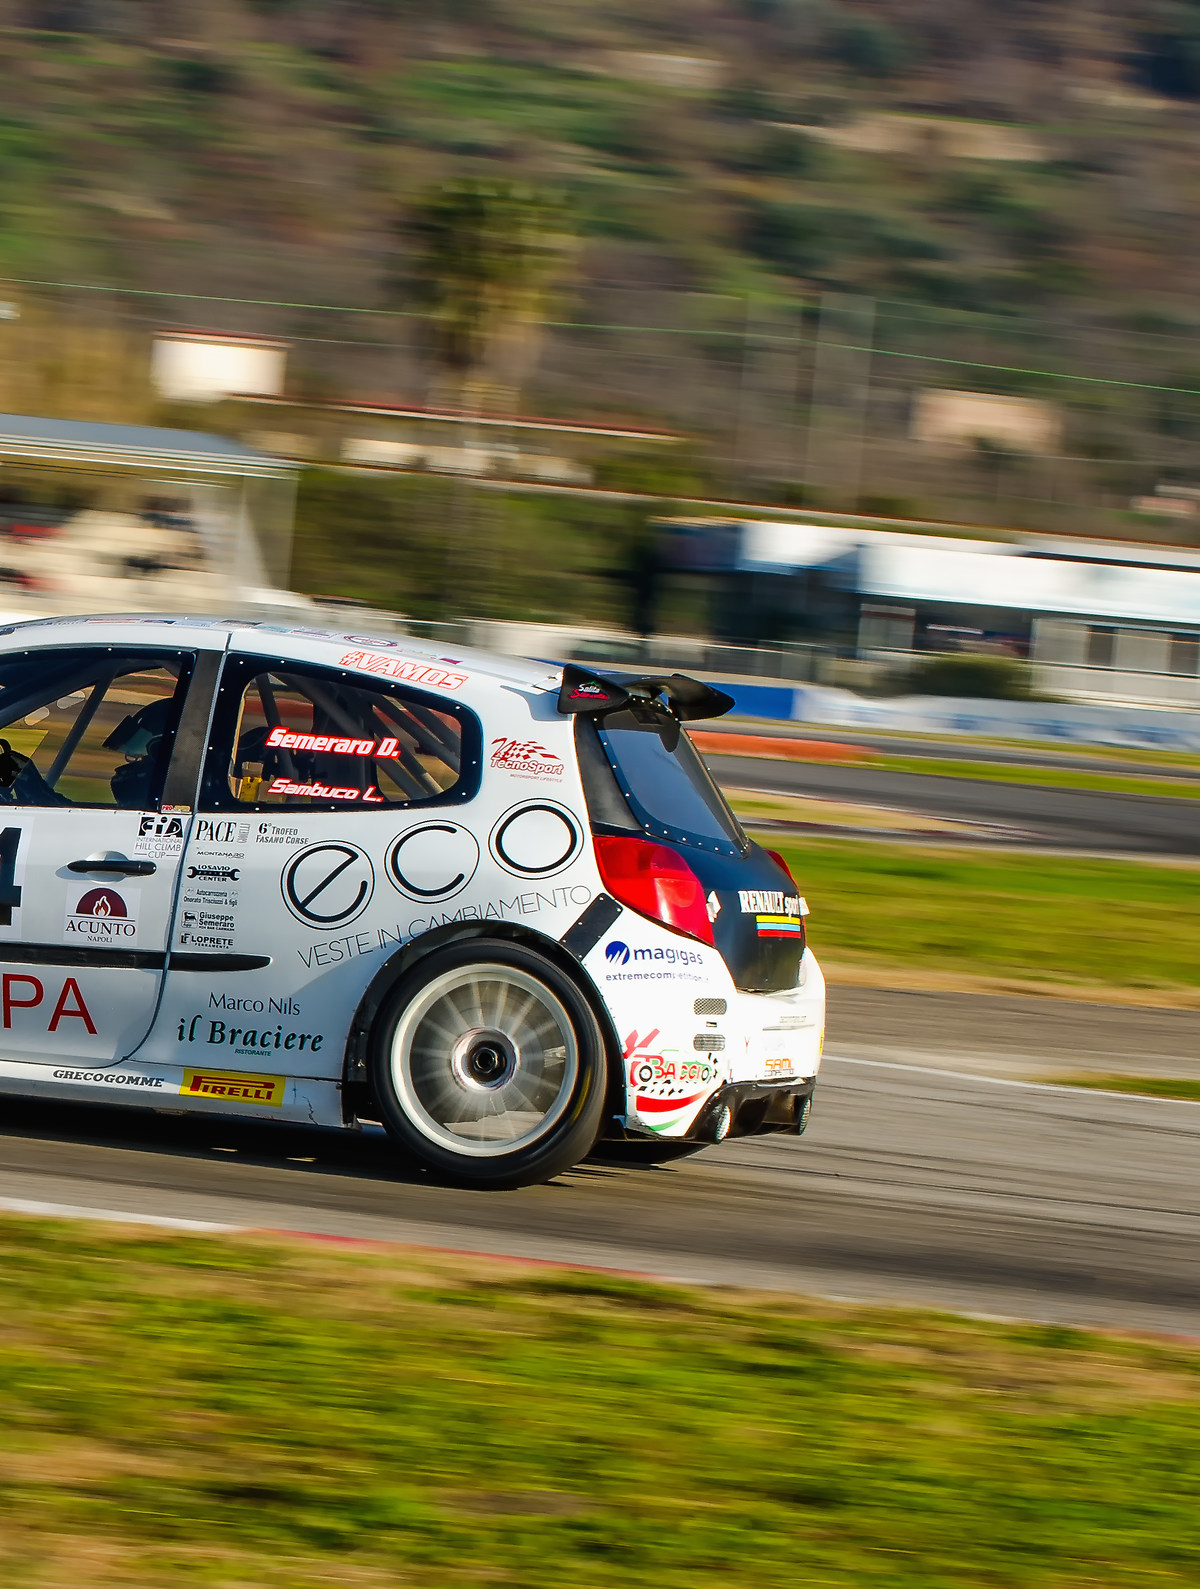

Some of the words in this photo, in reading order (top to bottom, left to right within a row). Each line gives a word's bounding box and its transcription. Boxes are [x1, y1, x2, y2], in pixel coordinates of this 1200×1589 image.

[339, 650, 470, 691] #VAMOS
[266, 727, 376, 756] Semeraro
[376, 738, 400, 758] D.
[490, 757, 565, 776] TecnoSport
[267, 778, 361, 801] Sambuco
[362, 786, 384, 803] L.
[194, 820, 237, 843] PACE
[135, 842, 152, 851] HILL
[154, 843, 182, 852] CLIMB
[147, 850, 167, 859] CUP
[737, 890, 785, 914] RENAULT
[198, 918, 235, 929] Semeraro
[199, 911, 235, 922] Giuseppe
[65, 919, 136, 937] ACUNTO
[297, 931, 371, 969] VESTE
[376, 924, 404, 949] IN
[407, 885, 592, 939] CAMBIAMENTO
[87, 935, 113, 943] NAPOLI
[191, 935, 234, 946] LOPRETE
[633, 948, 704, 966] magigas
[208, 991, 264, 1013] Marco
[268, 996, 302, 1016] Nils
[177, 1014, 203, 1043] il
[206, 1020, 324, 1053] Braciere
[234, 1048, 272, 1057] RISTORANTE
[52, 1069, 165, 1088] GRECOGOMME
[189, 1075, 276, 1100] PIRELLI
